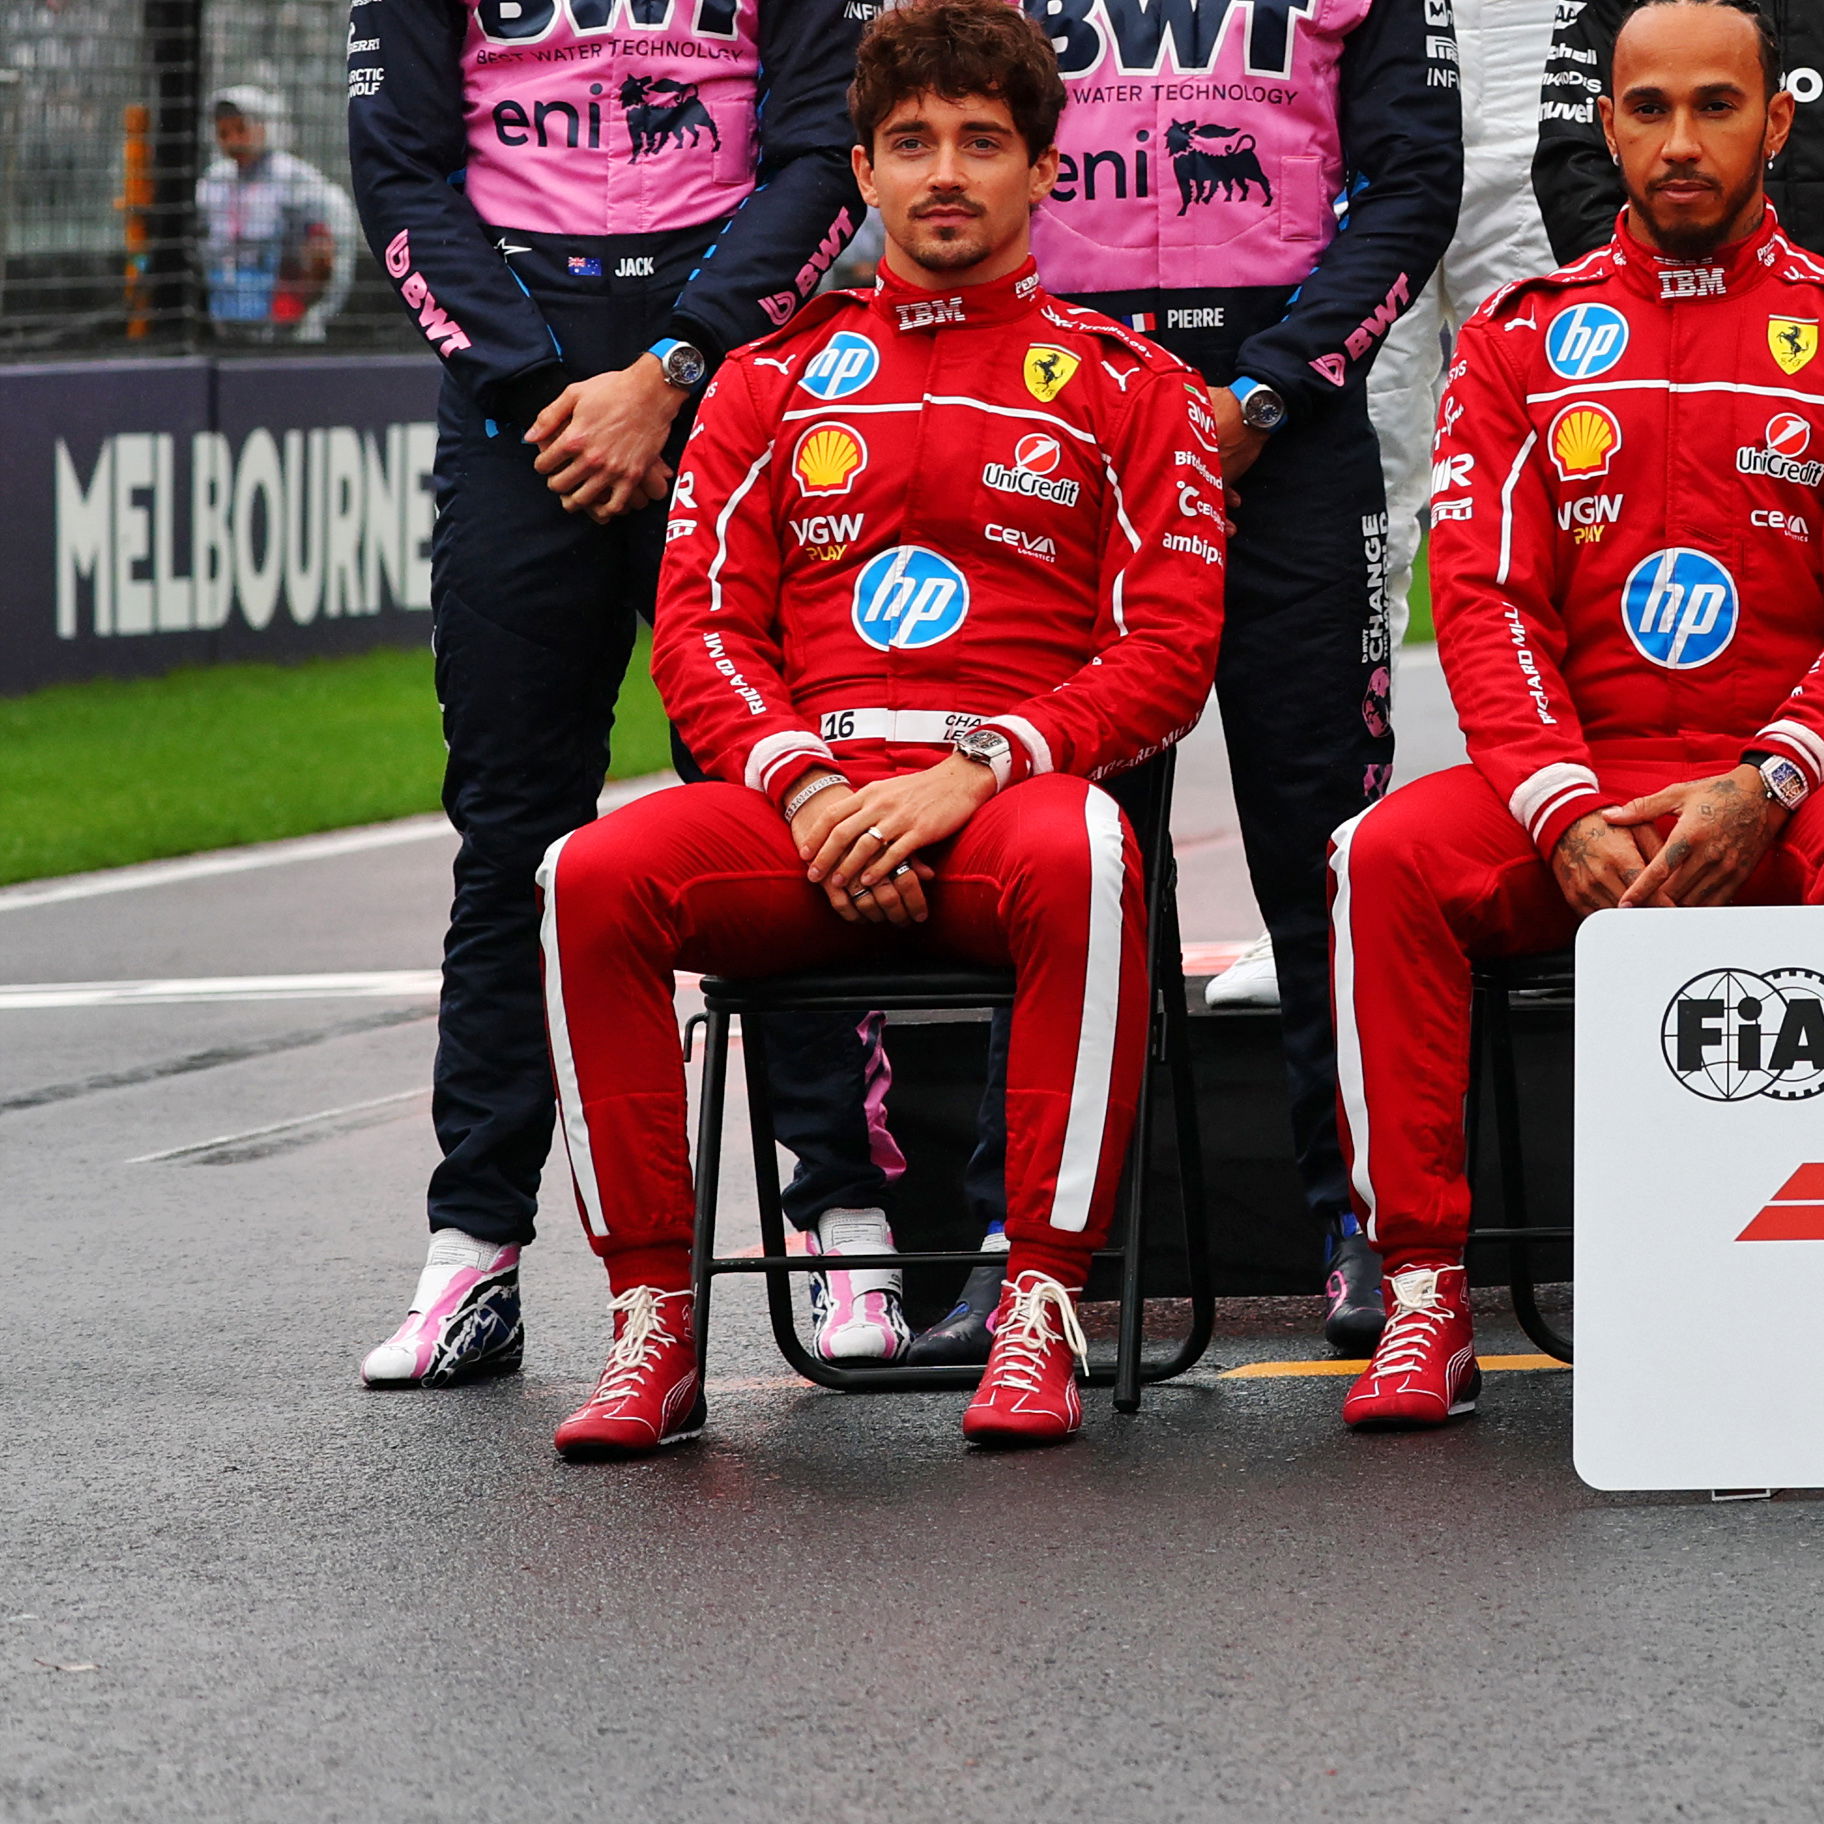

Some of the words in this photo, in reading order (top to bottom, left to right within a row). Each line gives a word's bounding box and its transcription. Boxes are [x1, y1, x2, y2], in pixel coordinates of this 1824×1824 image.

[1073, 84, 1142, 105] WATER
[1151, 84, 1299, 105] TECHNOLOGY
[492, 82, 602, 149] eni
[614, 257, 654, 277] JACK
[795, 206, 856, 296] BWT
[1658, 266, 1726, 299] IBM
[400, 272, 472, 357] BWT
[896, 296, 966, 331] IBM
[1167, 307, 1225, 329] PIERRE
[1343, 272, 1411, 361] BWT
[1736, 446, 1824, 487] UniCredit
[983, 464, 1080, 506] UniCredit
[789, 513, 864, 546] VGW
[1558, 493, 1624, 531] VGW
[55, 422, 438, 640] MELBOURNE
[1017, 547, 1056, 562] LOGISTICS
[825, 711, 854, 741] 16
